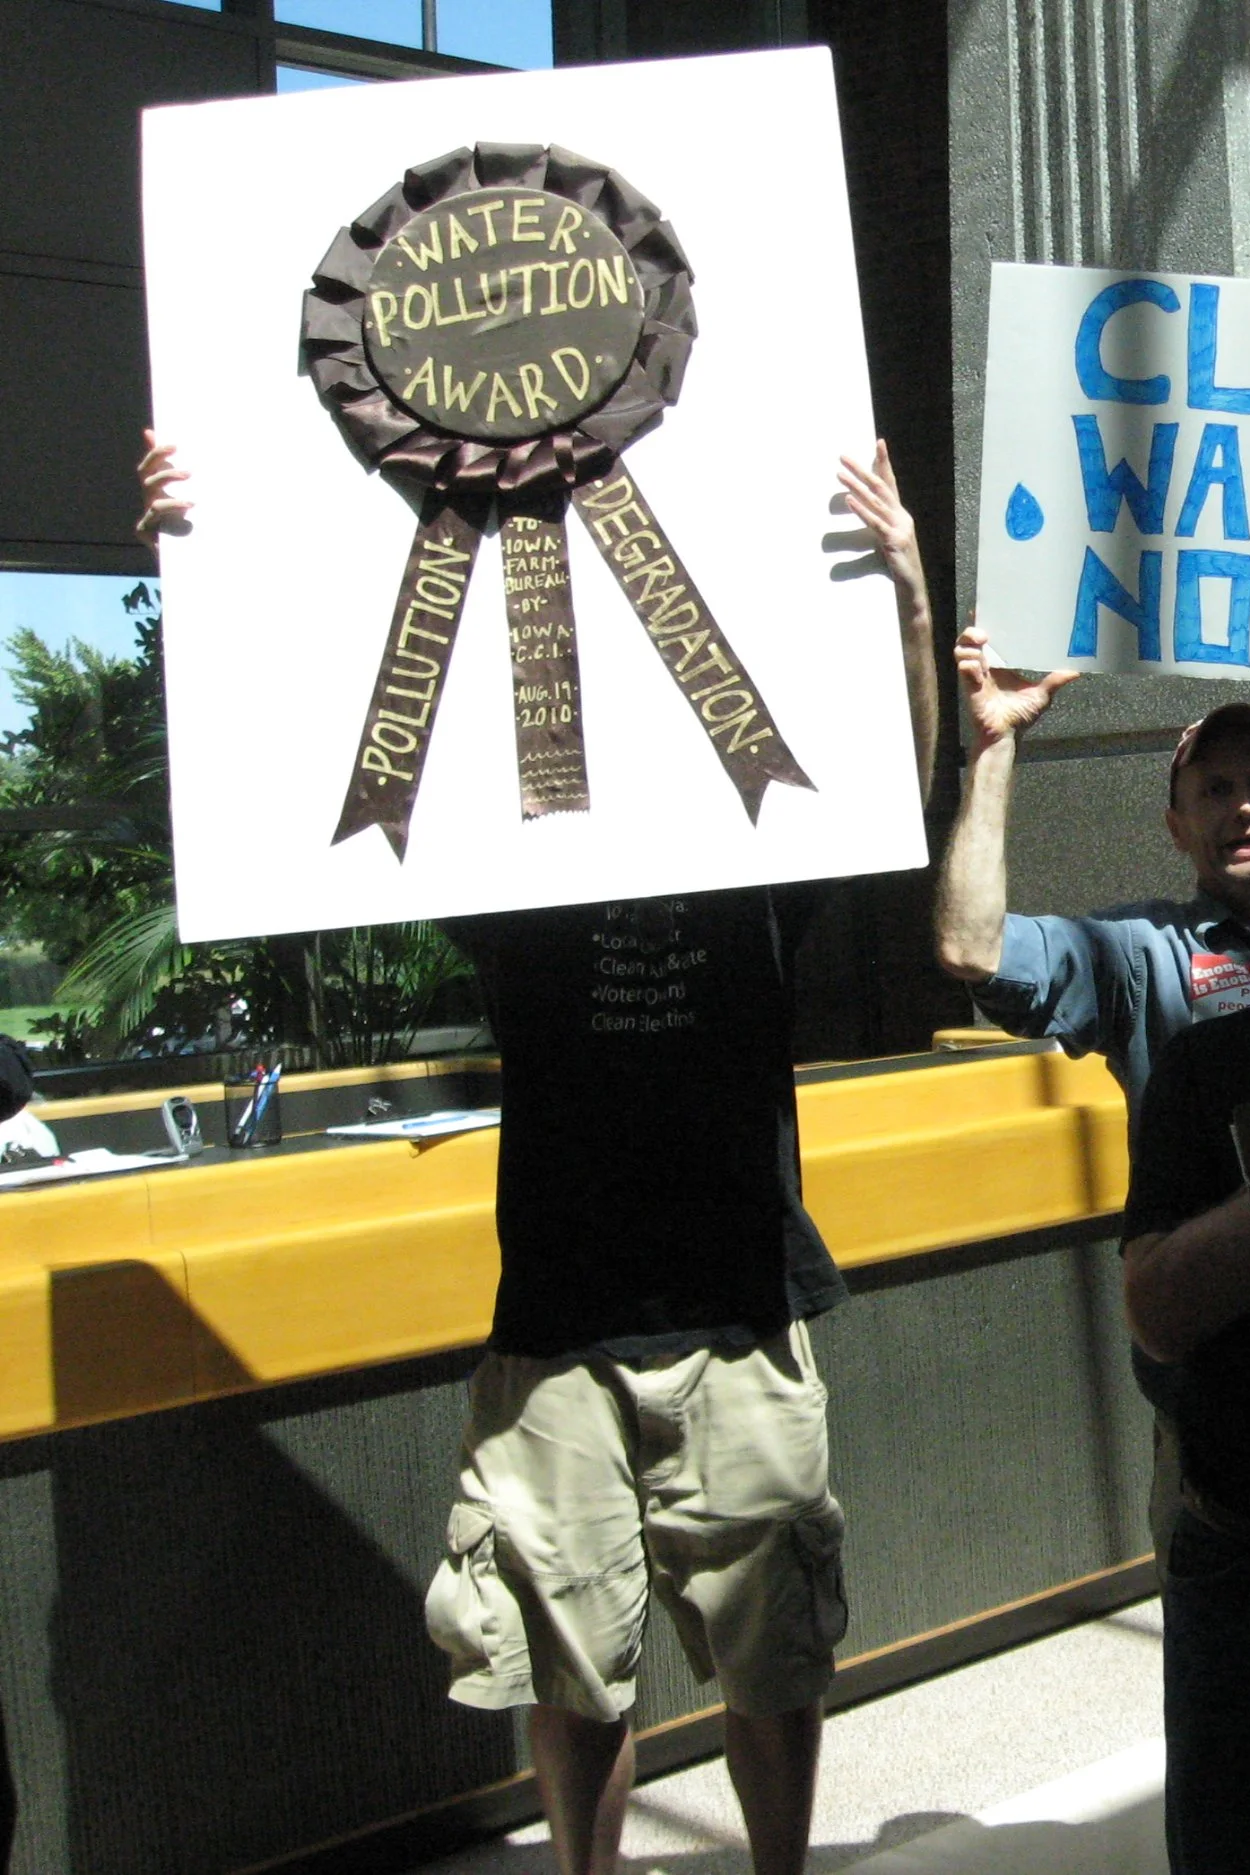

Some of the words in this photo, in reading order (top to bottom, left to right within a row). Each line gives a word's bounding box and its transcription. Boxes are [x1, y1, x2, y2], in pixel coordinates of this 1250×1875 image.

[400, 199, 583, 271] WATER
[371, 256, 628, 347] POLLUTION
[402, 347, 591, 422] AWARD
[512, 516, 538, 532] TO
[506, 536, 557, 554] IOWA
[506, 556, 556, 574] FARM
[505, 572, 566, 594] BUREAU
[582, 476, 773, 754] DEGRADATION
[512, 623, 570, 643] IOWA
[362, 540, 470, 782] POLLUTION
[520, 705, 571, 727] 2010
